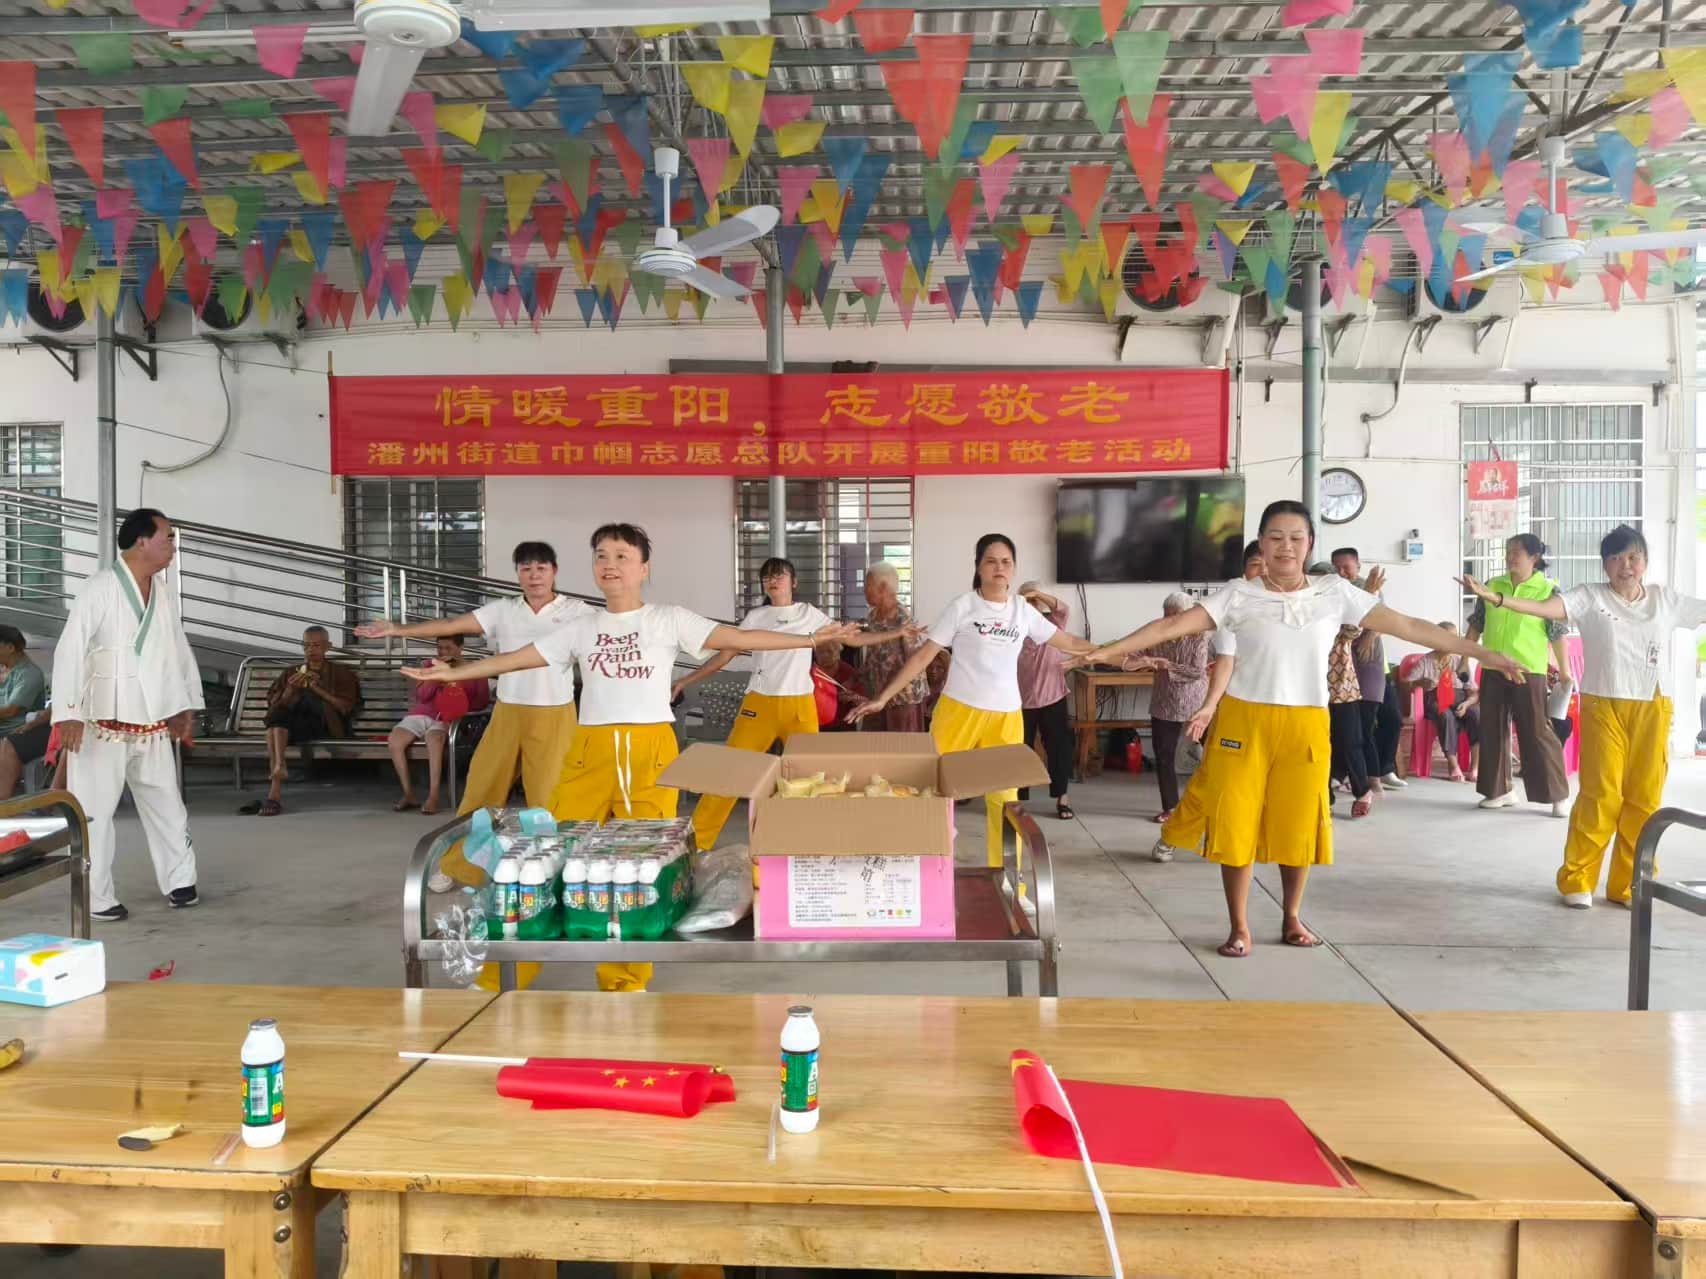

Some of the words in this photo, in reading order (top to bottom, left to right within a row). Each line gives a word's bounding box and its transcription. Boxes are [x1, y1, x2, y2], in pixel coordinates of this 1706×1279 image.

[368, 438, 1191, 465] 潘州街道巾帼志愿总队开展重阳敬老活动
[595, 632, 639, 647] Beep
